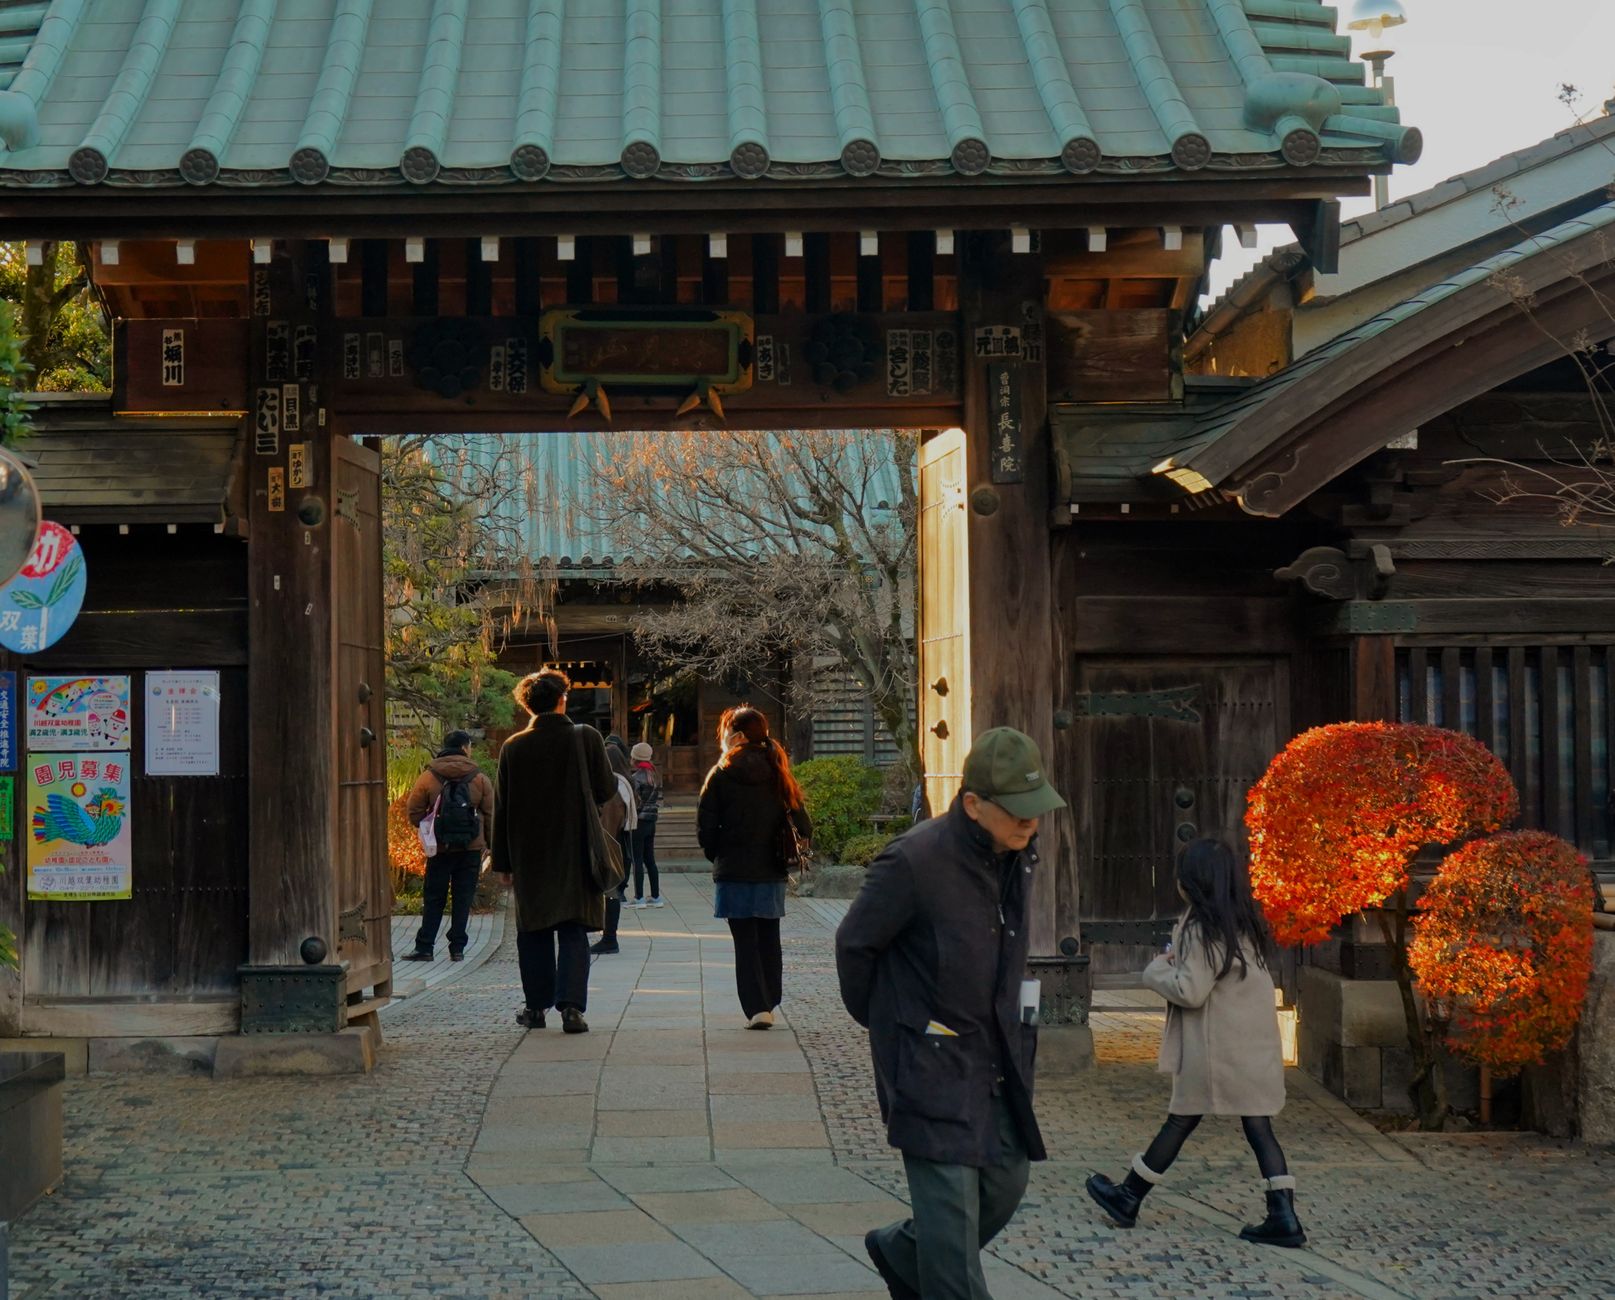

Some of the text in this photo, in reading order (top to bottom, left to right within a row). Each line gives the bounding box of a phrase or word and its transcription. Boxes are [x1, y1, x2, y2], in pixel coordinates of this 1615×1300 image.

[257, 390, 278, 453] たい三
[34, 760, 122, 785] 園児募集
